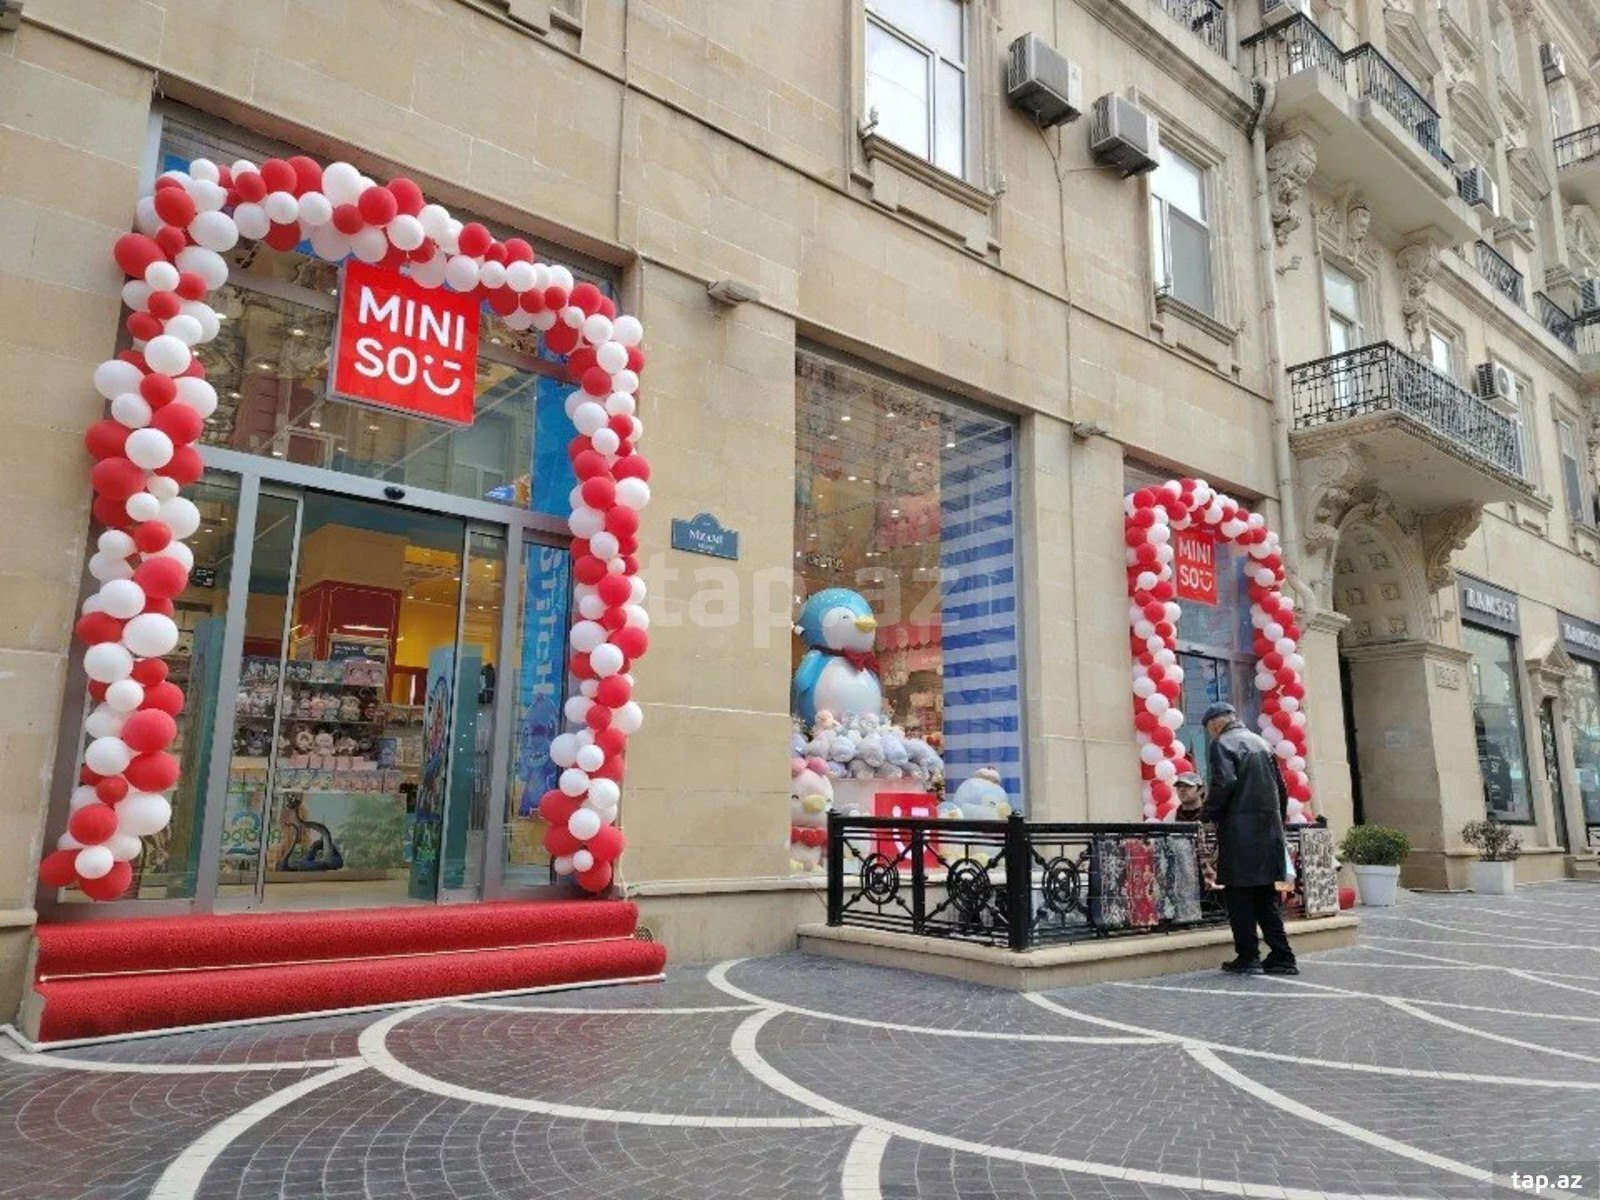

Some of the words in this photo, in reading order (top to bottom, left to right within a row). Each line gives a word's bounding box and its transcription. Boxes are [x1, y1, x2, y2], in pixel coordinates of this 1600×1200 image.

[358, 285, 465, 352] MINI
[354, 337, 418, 386] SO
[1179, 536, 1211, 566] MINI
